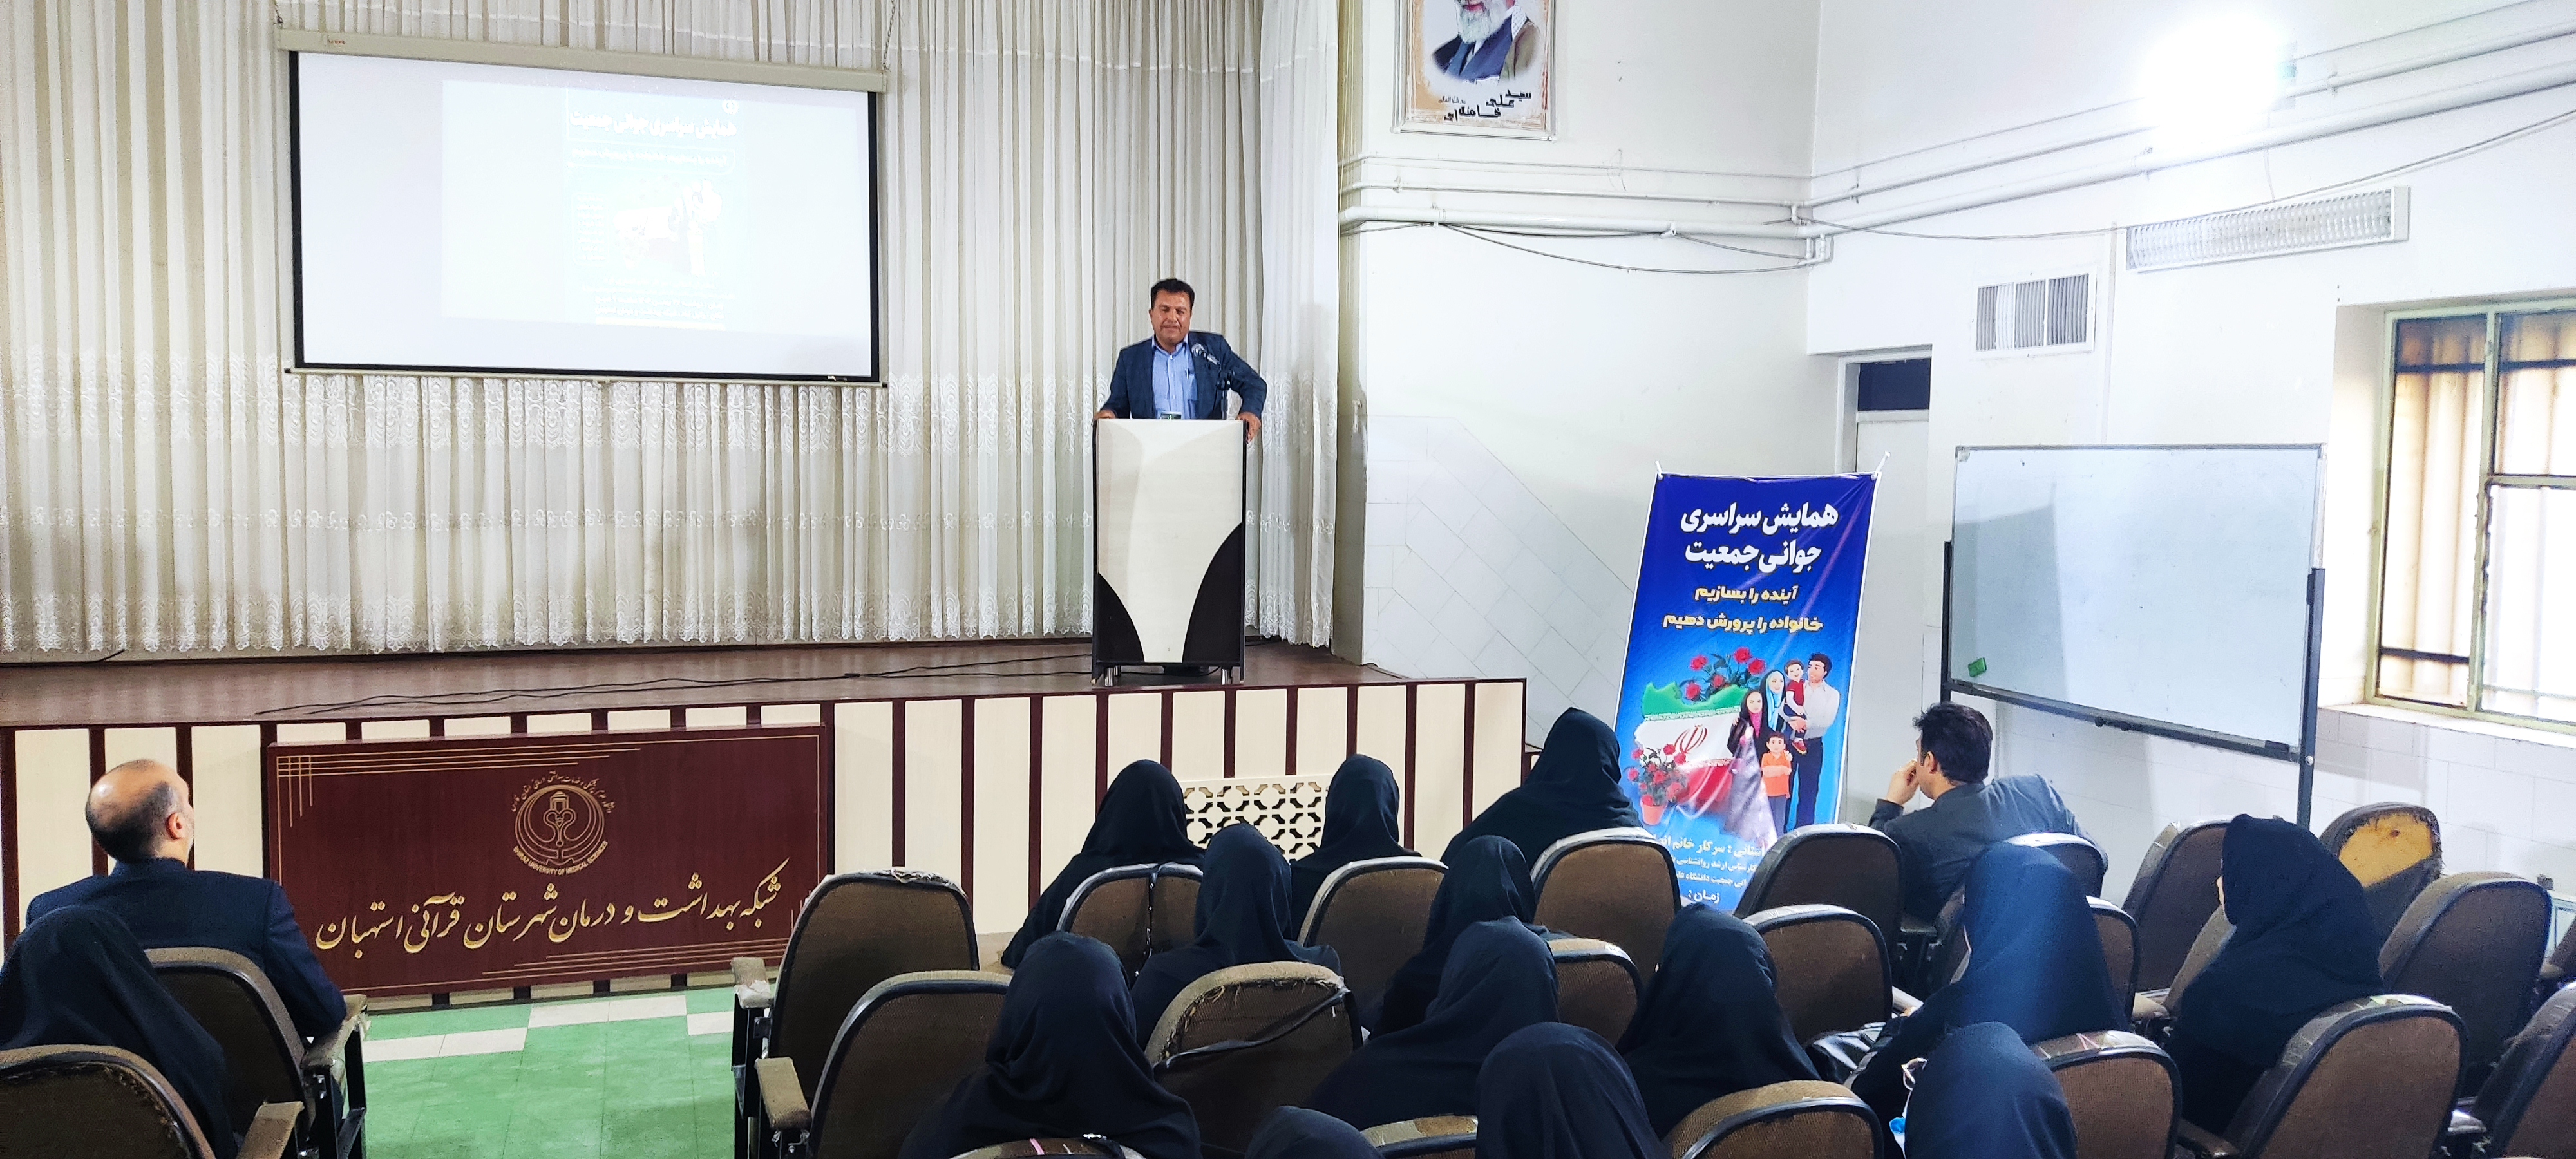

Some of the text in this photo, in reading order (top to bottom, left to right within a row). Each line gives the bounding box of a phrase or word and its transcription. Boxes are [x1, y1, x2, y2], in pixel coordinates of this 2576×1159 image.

[1486, 94, 1515, 108] علی
[1504, 89, 1532, 102] سید
[1680, 500, 1839, 534] همایش سراسری
[1685, 539, 1822, 574] جوانی جمعیت
[1694, 585, 1799, 606] آینده را بسازیم
[1663, 612, 1824, 634] خانواده را پرورش دهیم
[1672, 837, 1694, 850] خانم
[1694, 889, 1720, 904] زمان
[316, 857, 791, 959] شبکه بهداشت و درمان شهرستان قرآنی استهبان
